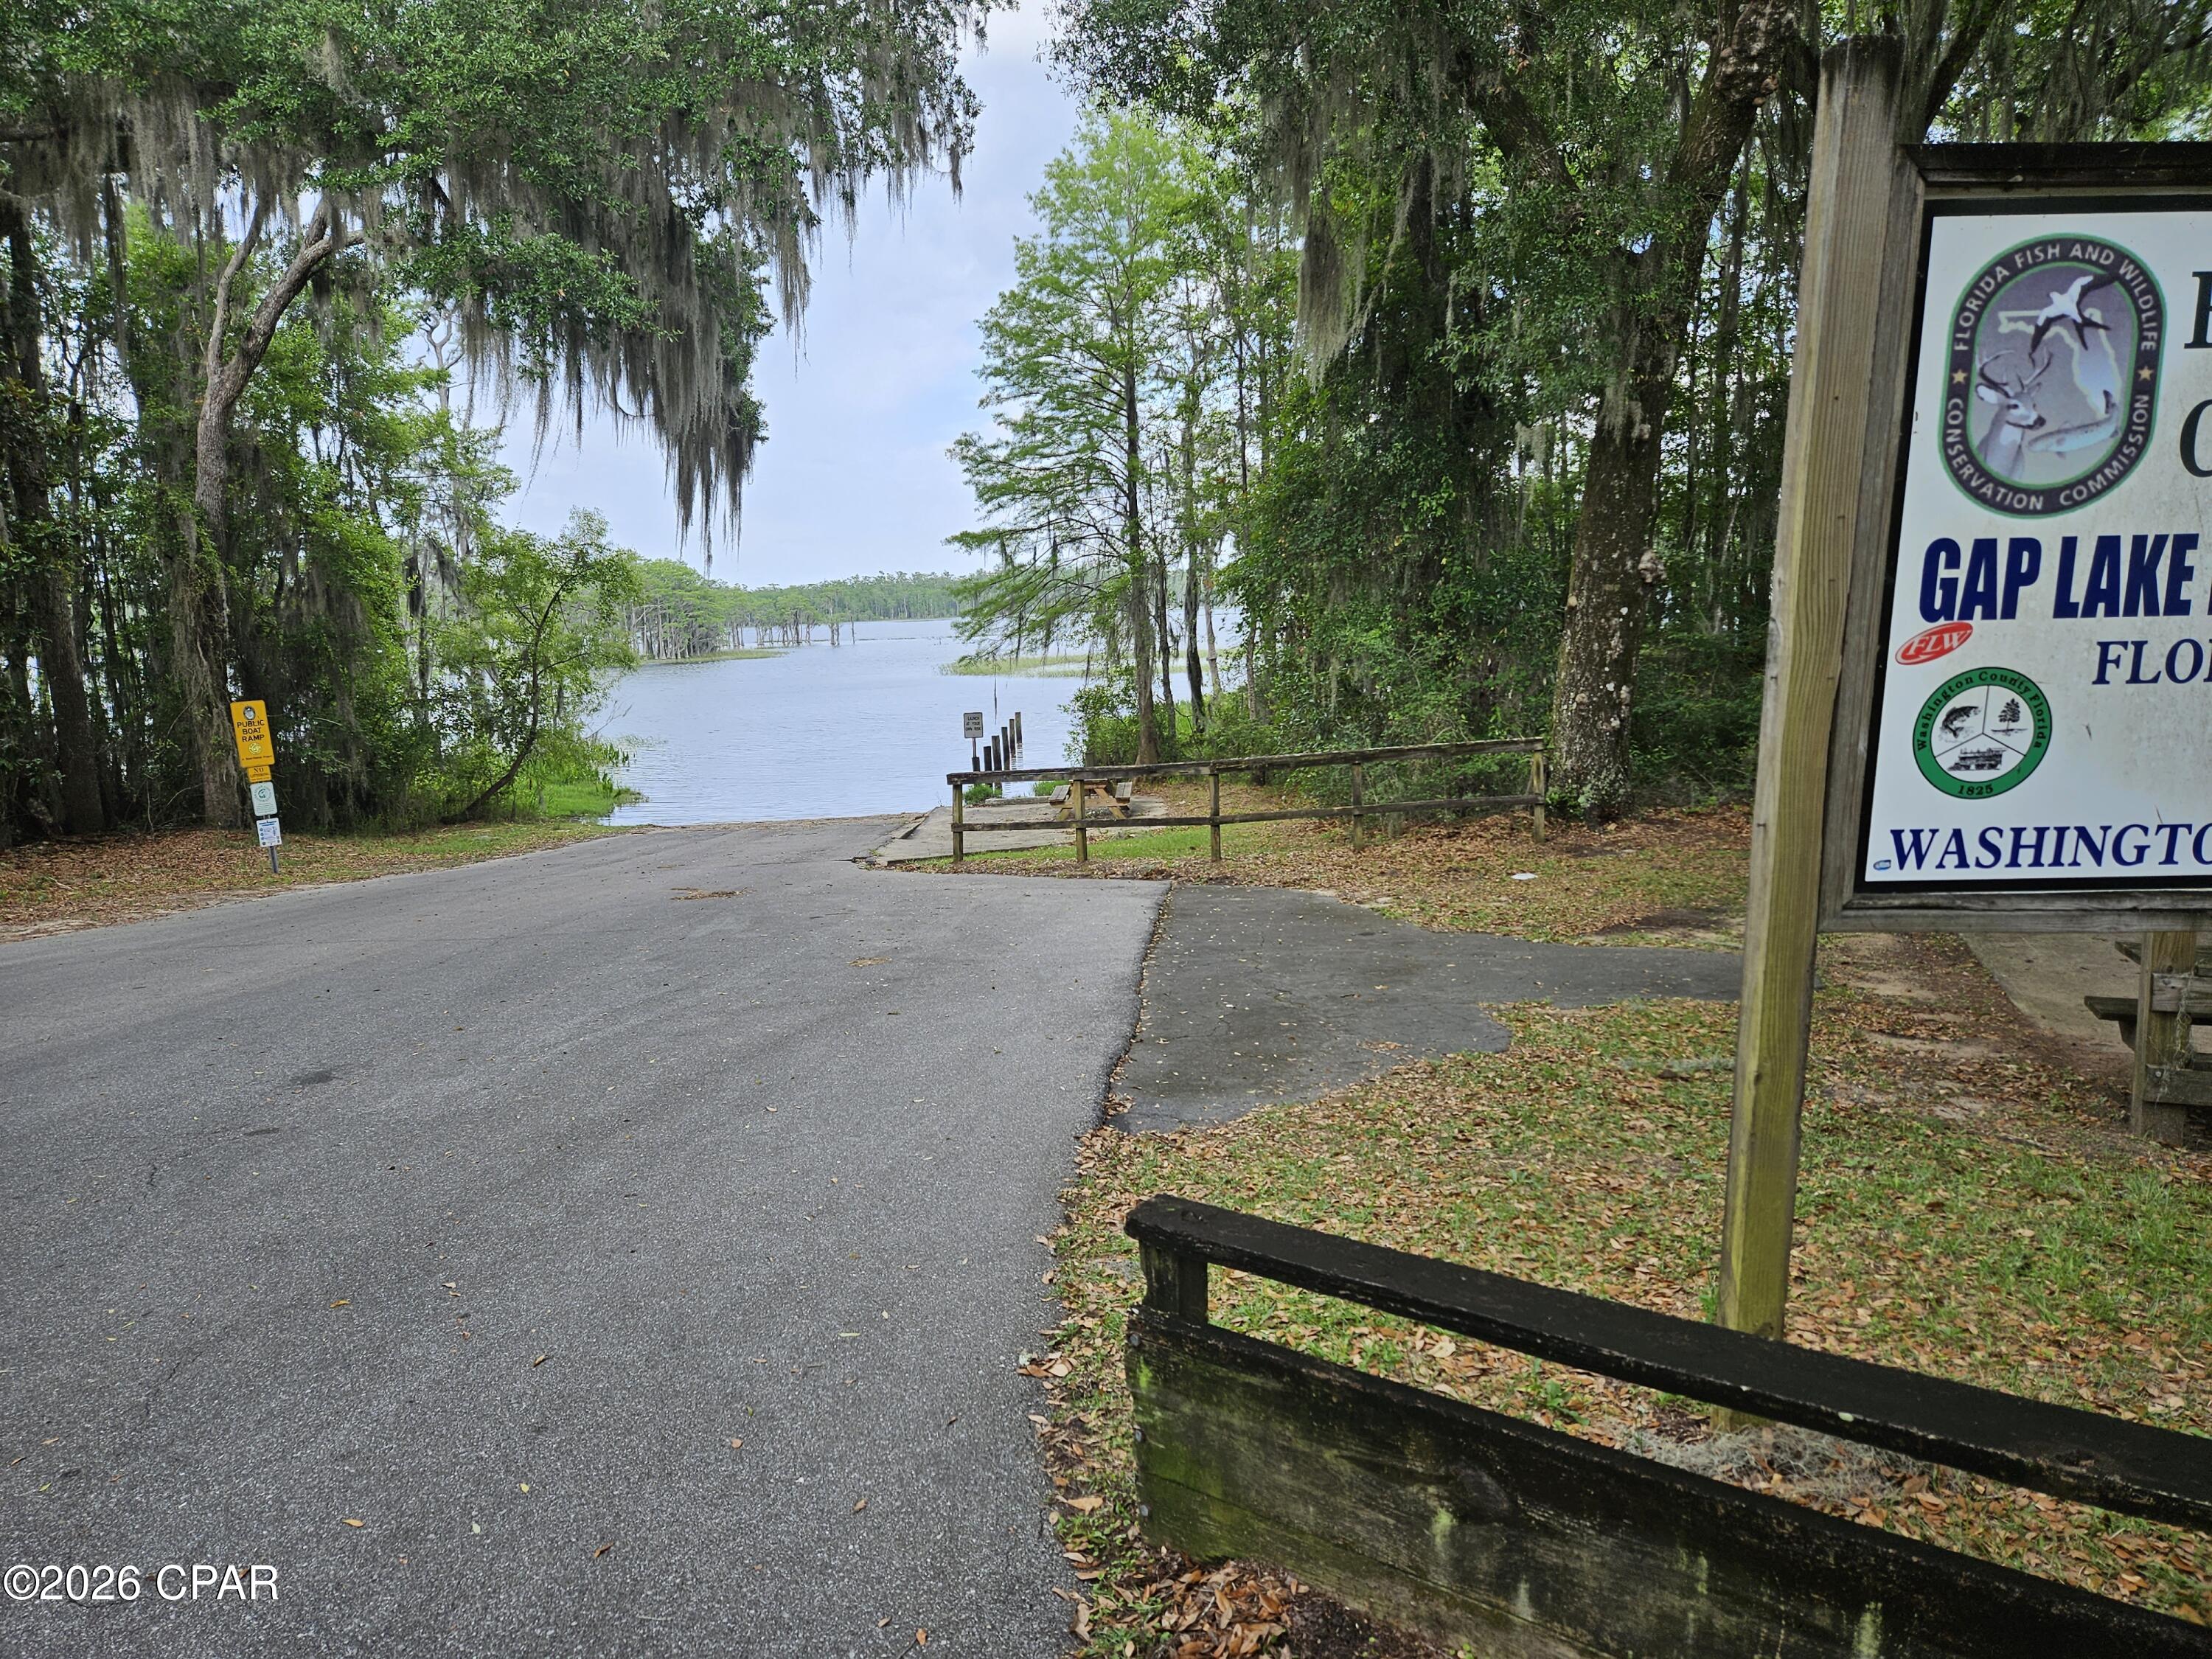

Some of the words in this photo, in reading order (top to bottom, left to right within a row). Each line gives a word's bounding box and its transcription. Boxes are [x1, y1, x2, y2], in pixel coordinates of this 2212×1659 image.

[1954, 264, 2011, 351] FLORIDA
[2014, 243, 2060, 266] FISH
[2069, 243, 2115, 265] AND
[2118, 259, 2157, 351] WILDLIFE
[1946, 398, 2043, 510] CONSERVATION
[2059, 394, 2149, 507] COMMISSION
[1919, 538, 2042, 623] GAP
[2053, 533, 2199, 619] LAKE
[1907, 630, 1972, 655] FLW
[2092, 639, 2212, 684] FLO
[237, 720, 265, 728] PUBLIC
[1918, 676, 1973, 751] Washington
[1978, 671, 2031, 695] County
[2029, 692, 2048, 748] Florida
[1958, 785, 1994, 795] 1825
